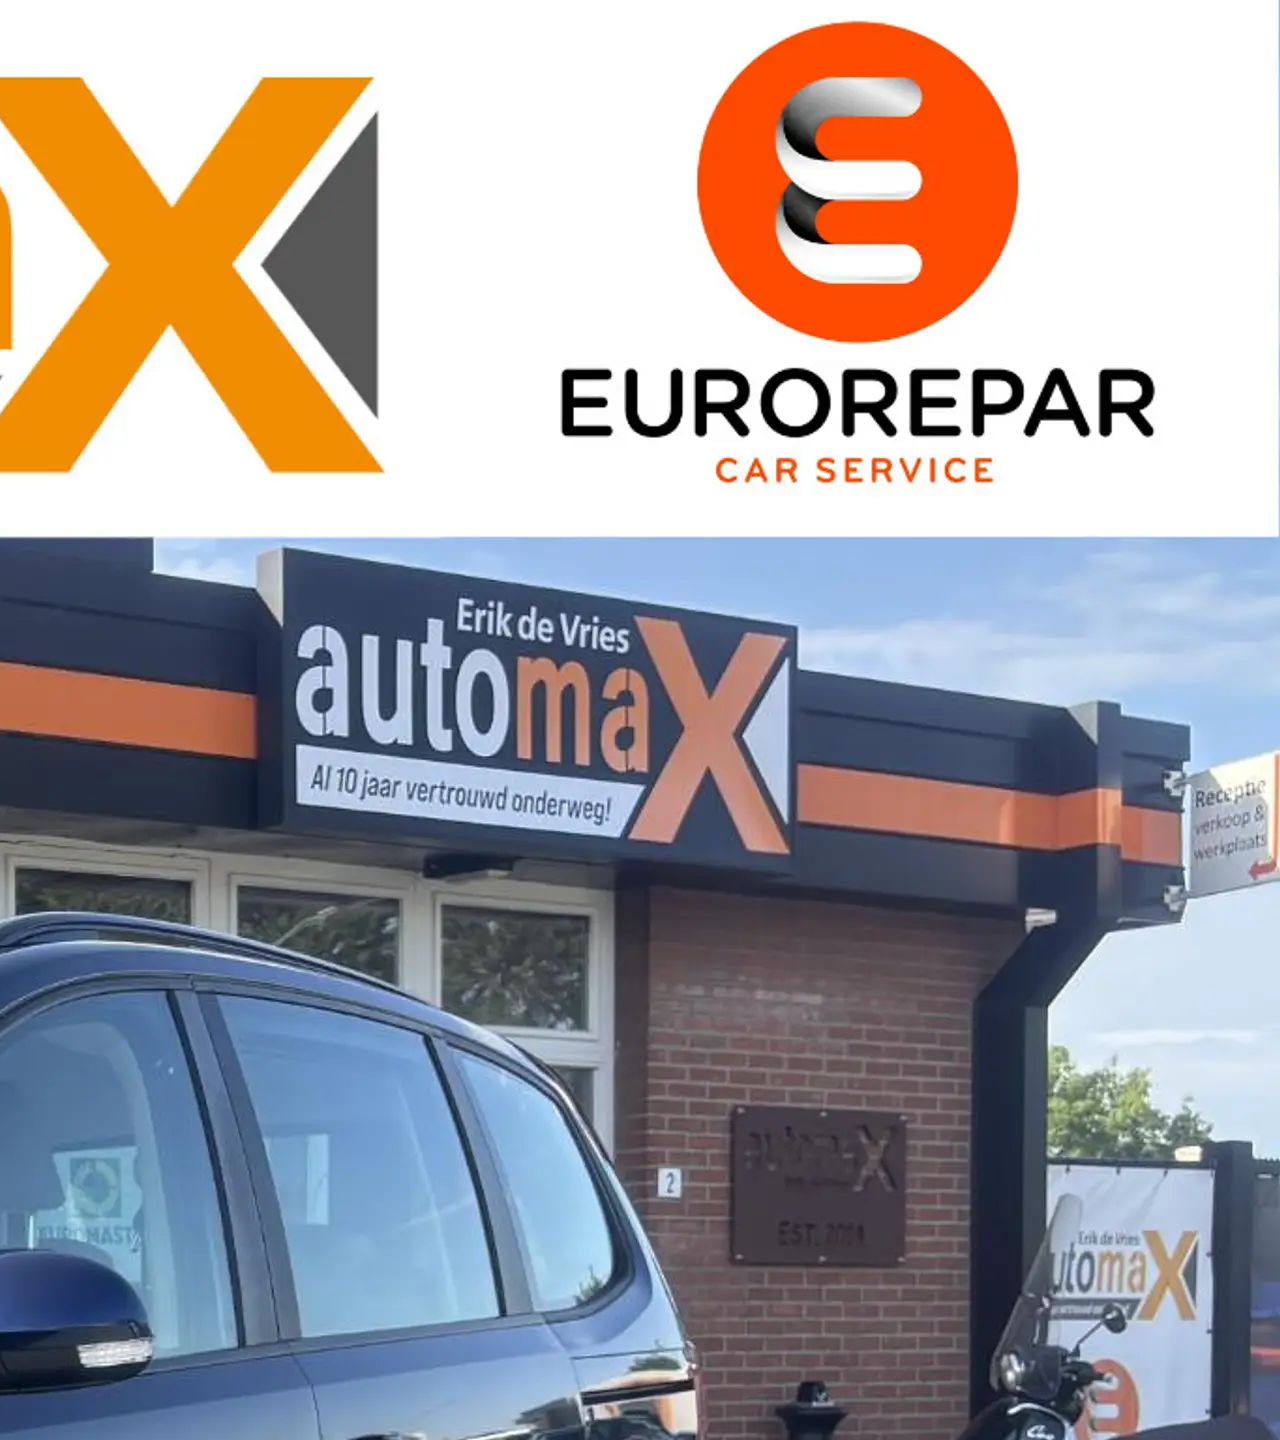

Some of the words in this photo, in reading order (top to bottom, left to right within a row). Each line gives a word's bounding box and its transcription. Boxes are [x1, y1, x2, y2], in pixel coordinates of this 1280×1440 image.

[456, 597, 513, 639] Erik
[517, 603, 556, 644] de
[559, 611, 631, 654] Vries
[295, 615, 791, 855] automaX
[311, 764, 333, 791] Al
[336, 766, 358, 795] 10
[360, 768, 403, 803] jaar
[405, 772, 508, 812] vertrouwd
[512, 789, 612, 826] onderweg!
[1194, 778, 1267, 809] Receptie
[1194, 808, 1251, 837] verkoop
[1253, 806, 1266, 824] &
[1193, 832, 1267, 861] werkplaats
[666, 1172, 676, 1193] 2
[1078, 1231, 1098, 1245] Erik
[1100, 1231, 1113, 1245] de
[1115, 1231, 1140, 1246] Vries
[1051, 1230, 1198, 1320] utomaX
